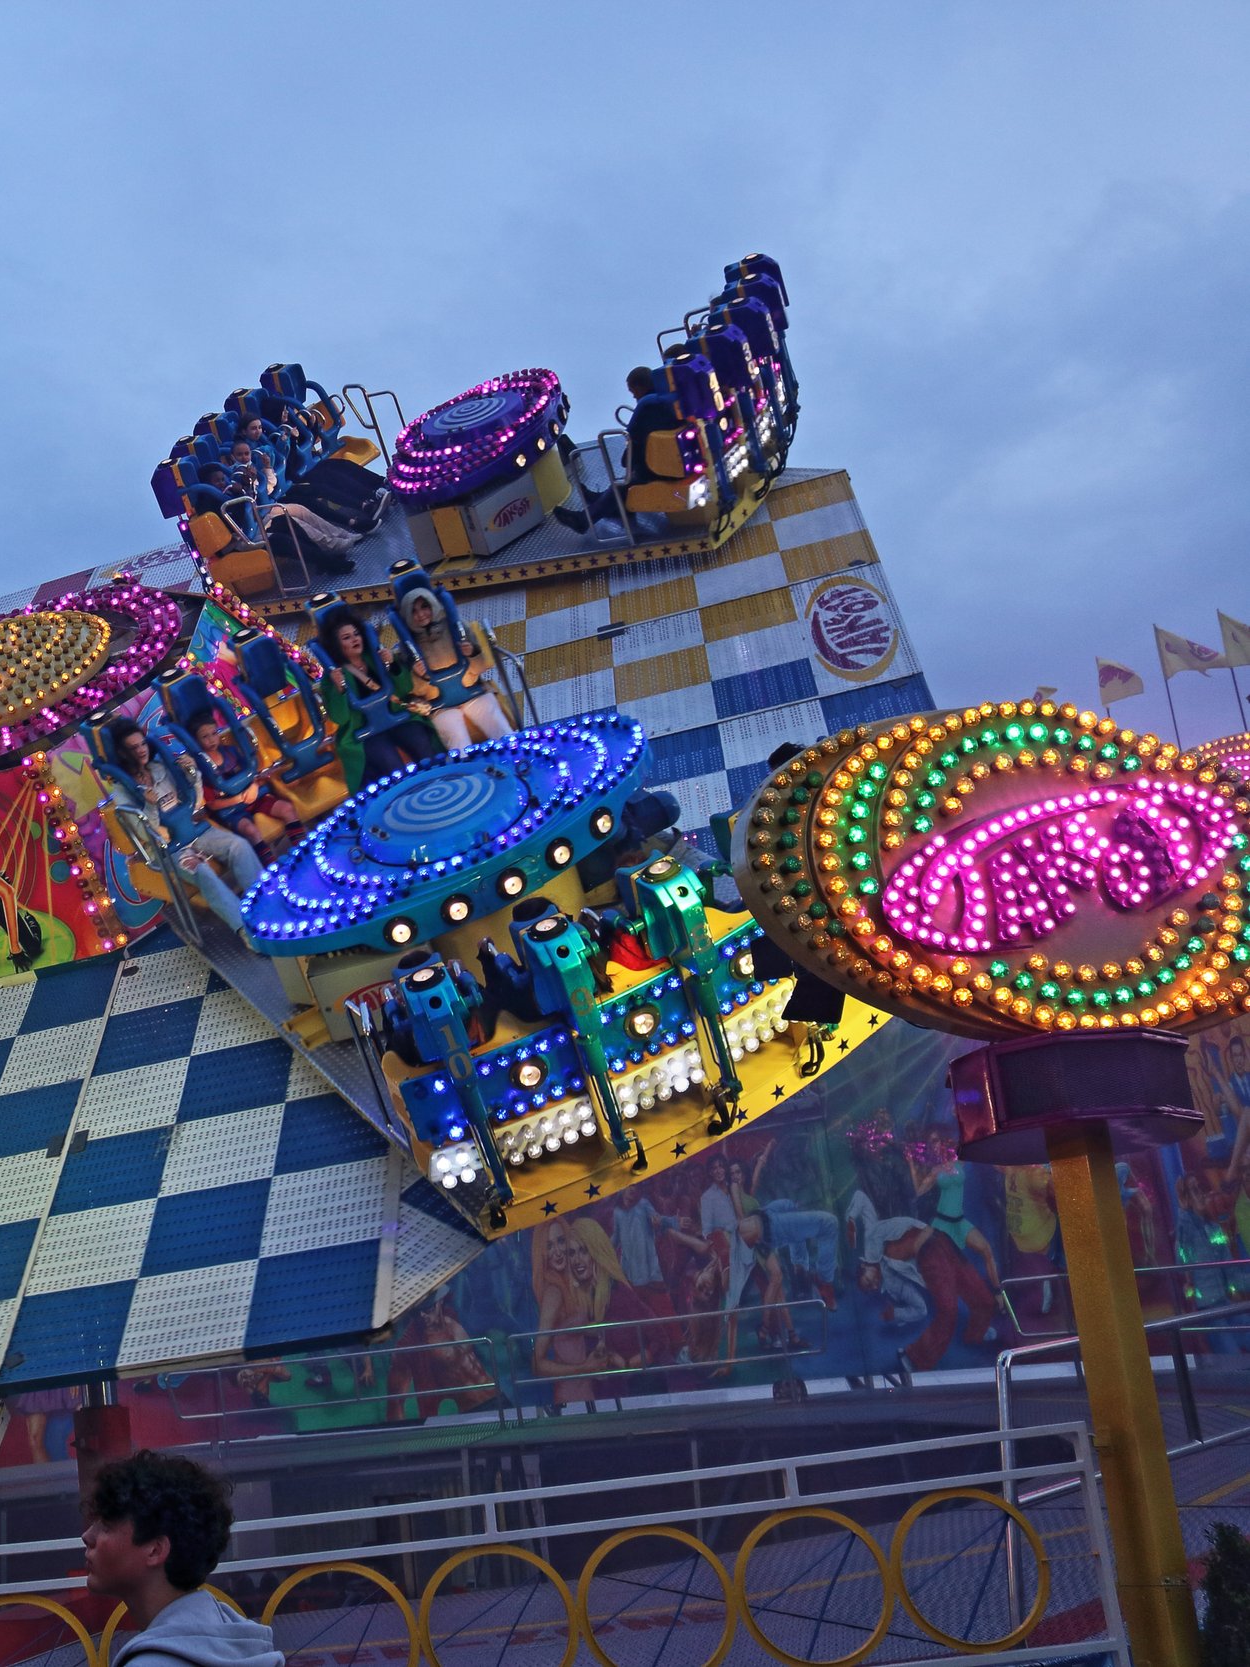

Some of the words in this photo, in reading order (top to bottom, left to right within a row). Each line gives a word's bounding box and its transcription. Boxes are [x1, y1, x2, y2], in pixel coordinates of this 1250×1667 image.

[709, 371, 725, 412] 40
[691, 924, 711, 952] 8
[569, 988, 595, 1016] 9
[439, 1024, 472, 1080] 10
